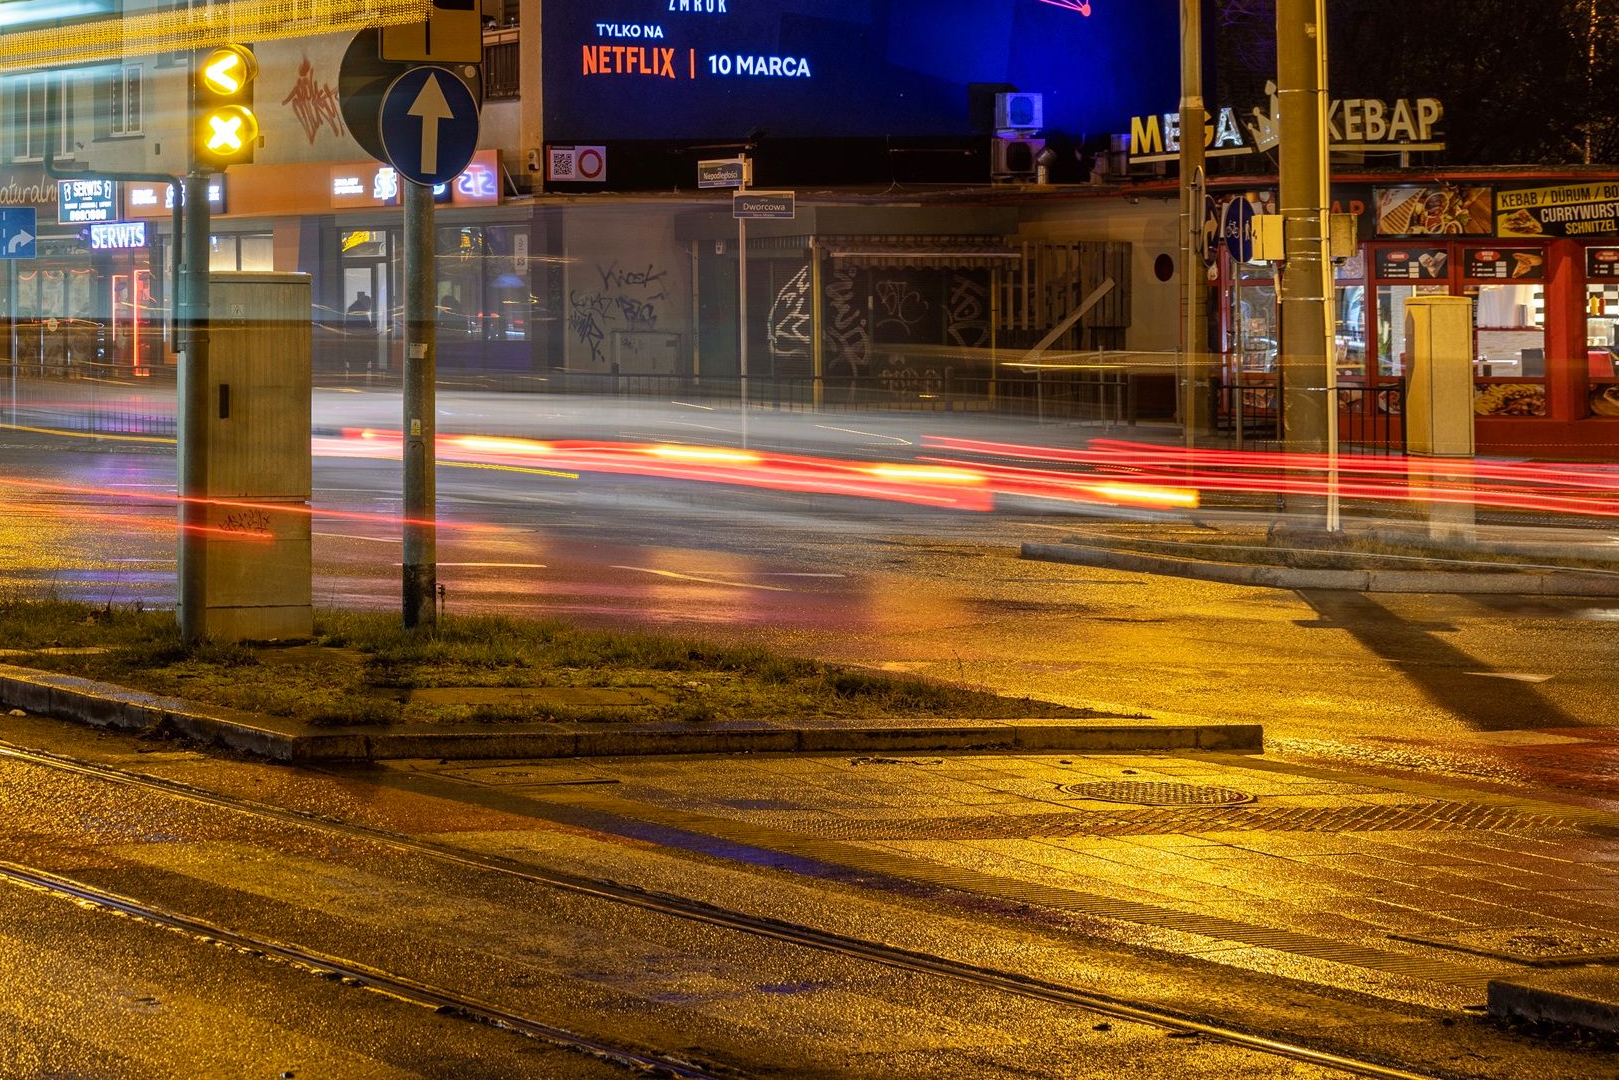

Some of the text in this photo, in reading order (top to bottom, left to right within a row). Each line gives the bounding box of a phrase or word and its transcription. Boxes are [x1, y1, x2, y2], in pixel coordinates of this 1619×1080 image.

[596, 23, 664, 39] TYLKO NA
[582, 44, 811, 79] NETFLIX 10 MARCA
[1130, 107, 1244, 155] MEA
[73, 180, 102, 197] SERWIS
[1500, 191, 1539, 208] KEBAB
[1550, 186, 1591, 204] DÜRUM
[1603, 184, 1619, 199] BO
[742, 202, 786, 211] Dworcowa
[1540, 202, 1619, 223] CURRYWURST
[91, 225, 145, 249] SERWIS
[1564, 219, 1618, 235] SCHNITZEL
